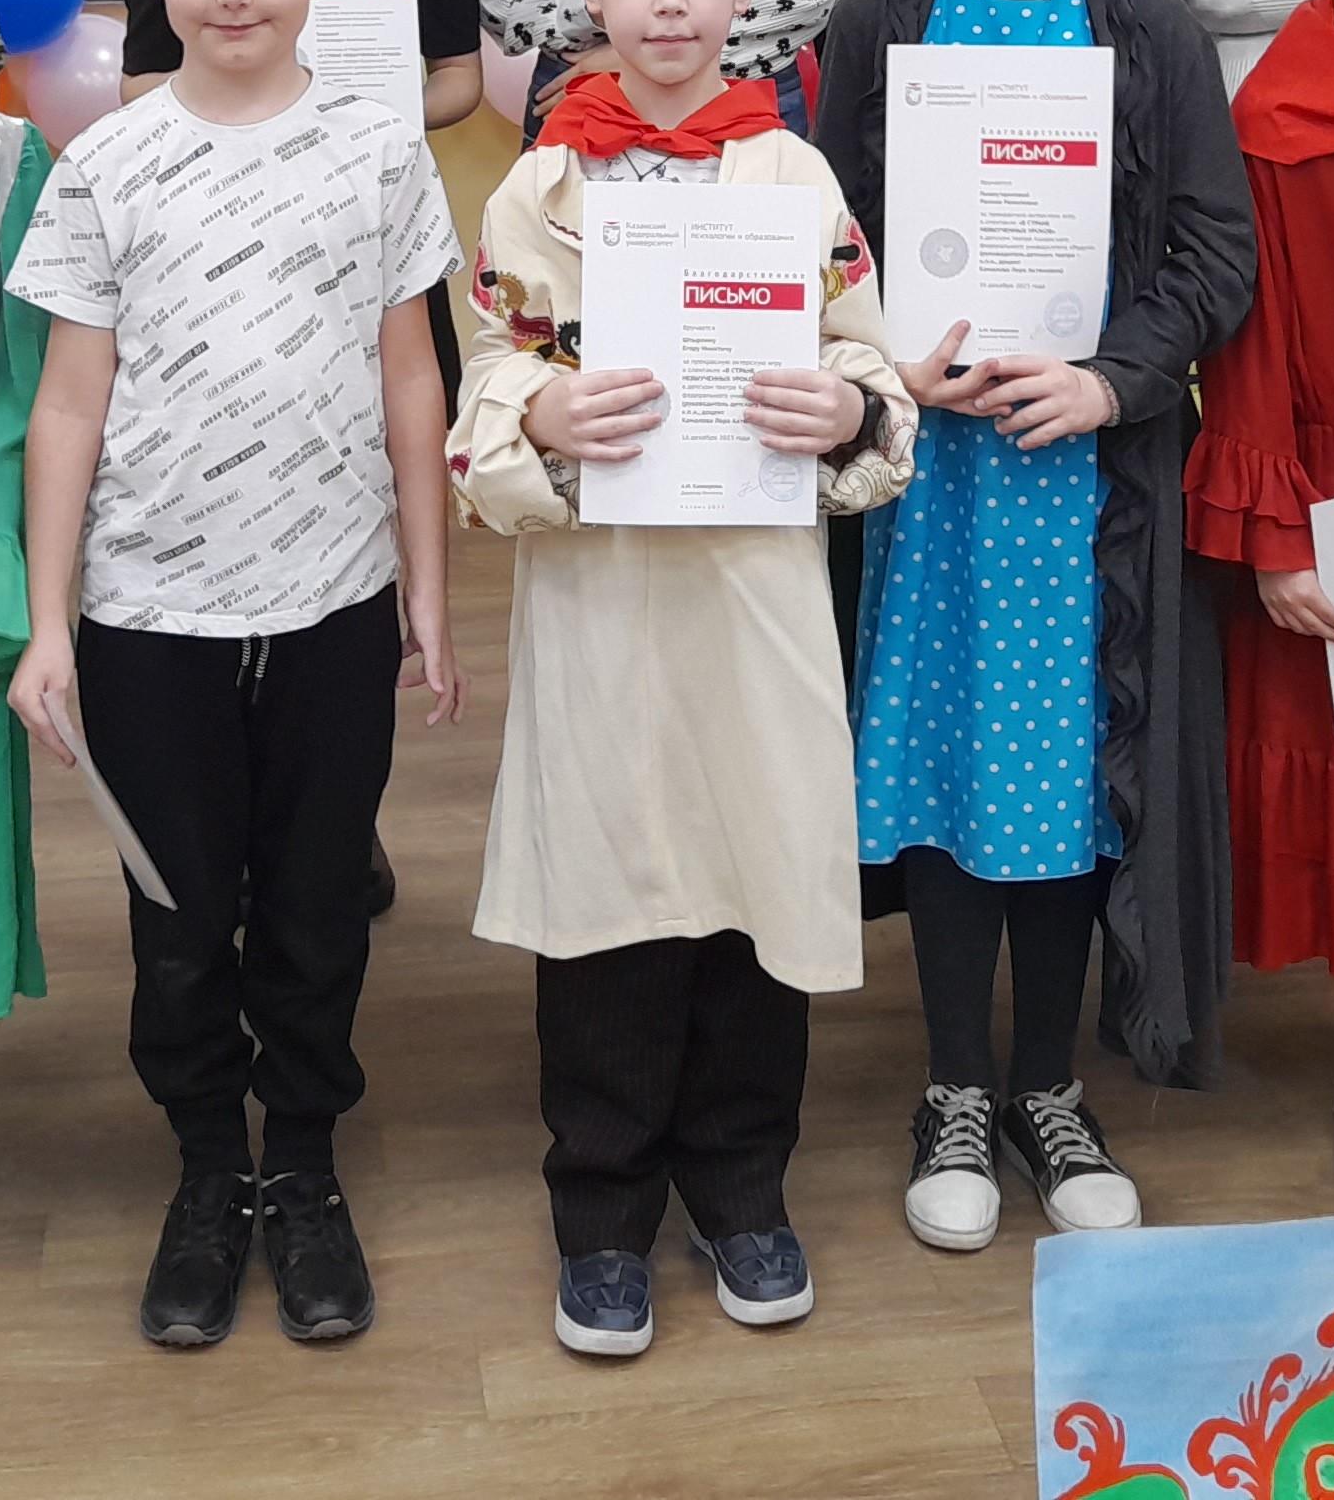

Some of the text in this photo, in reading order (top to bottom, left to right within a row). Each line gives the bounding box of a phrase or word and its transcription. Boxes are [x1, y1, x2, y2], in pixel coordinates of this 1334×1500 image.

[983, 143, 1066, 162] ПИСЬМО
[691, 223, 734, 232] ИНСТИТУТ
[684, 269, 806, 280] Благодарственное
[685, 286, 772, 305] ПИСЬМО
